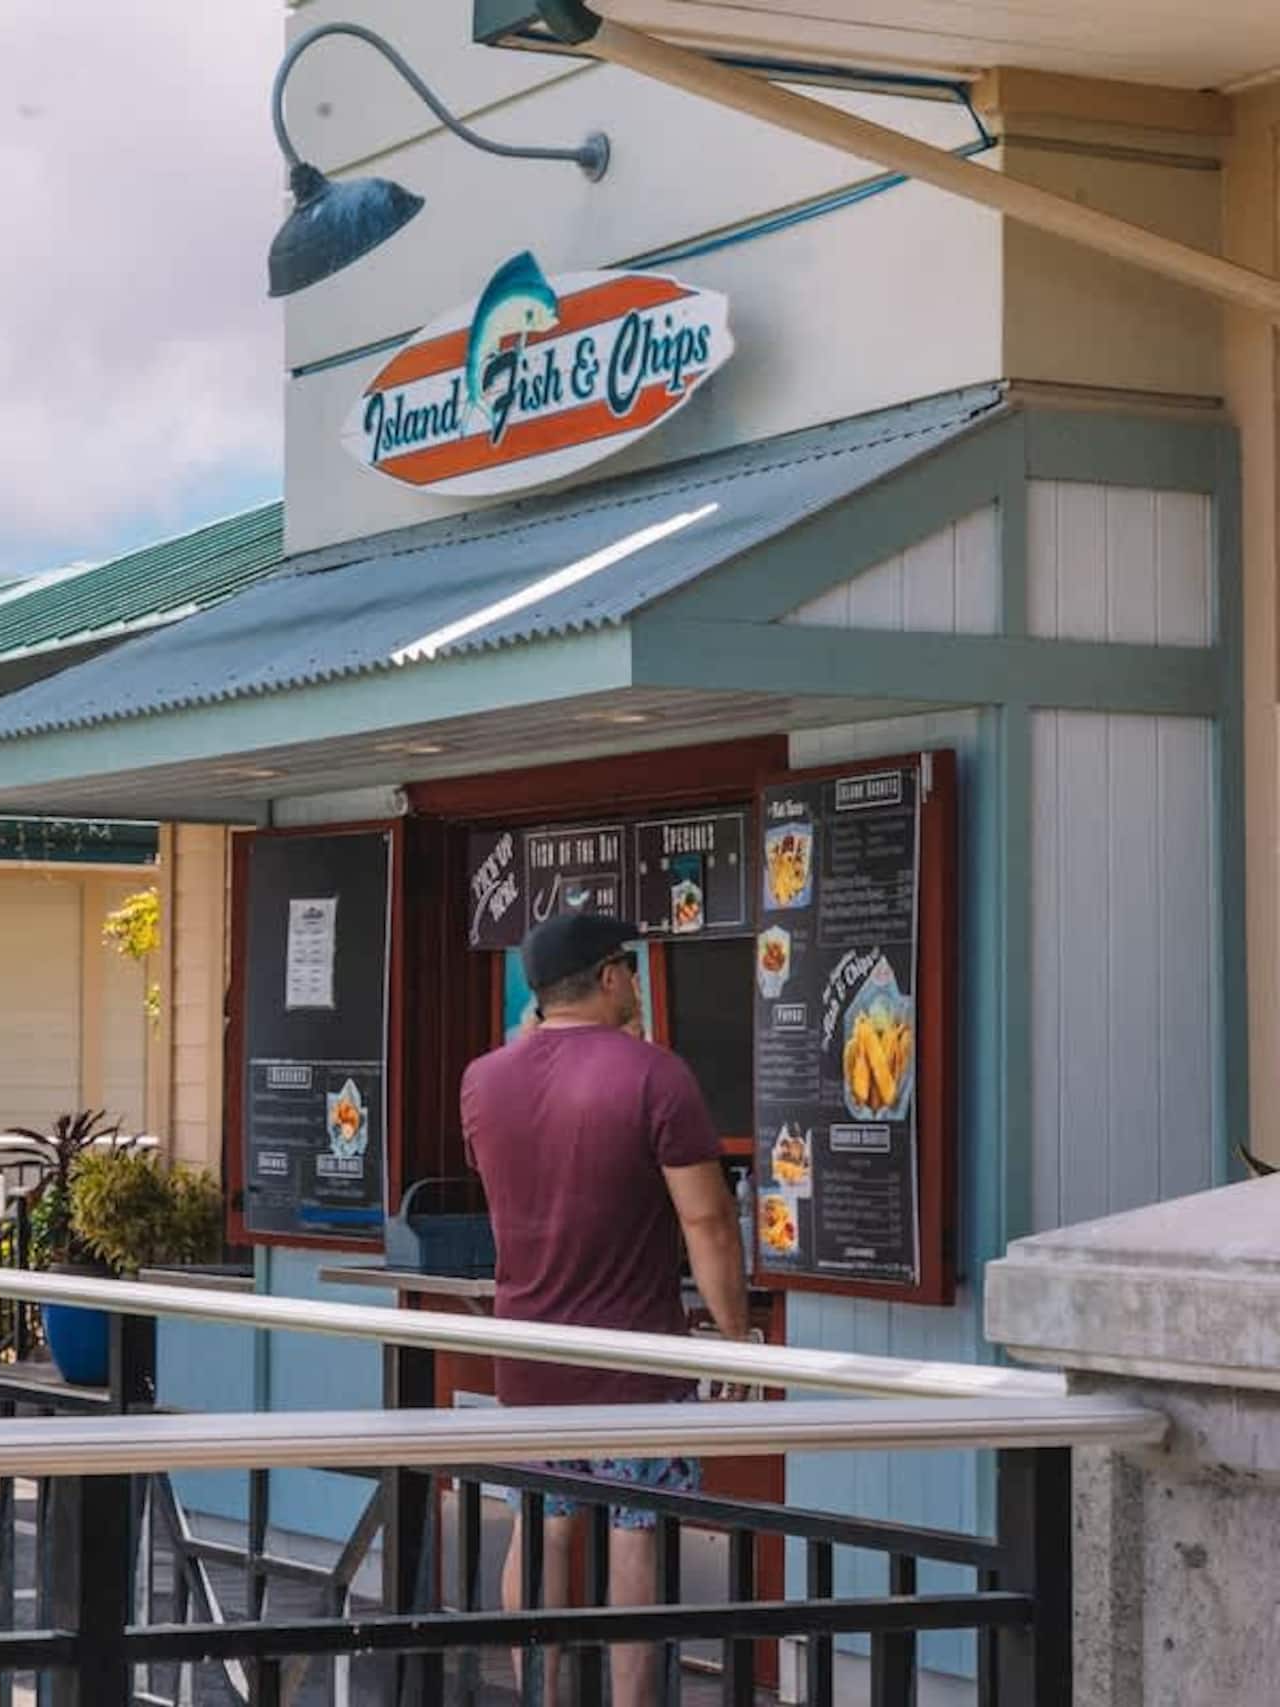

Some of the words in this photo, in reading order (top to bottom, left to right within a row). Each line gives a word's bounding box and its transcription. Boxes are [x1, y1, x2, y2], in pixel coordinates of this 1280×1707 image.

[363, 379, 462, 462] Island
[482, 350, 563, 444] Fish
[569, 336, 599, 399] &
[607, 311, 712, 414] Chips
